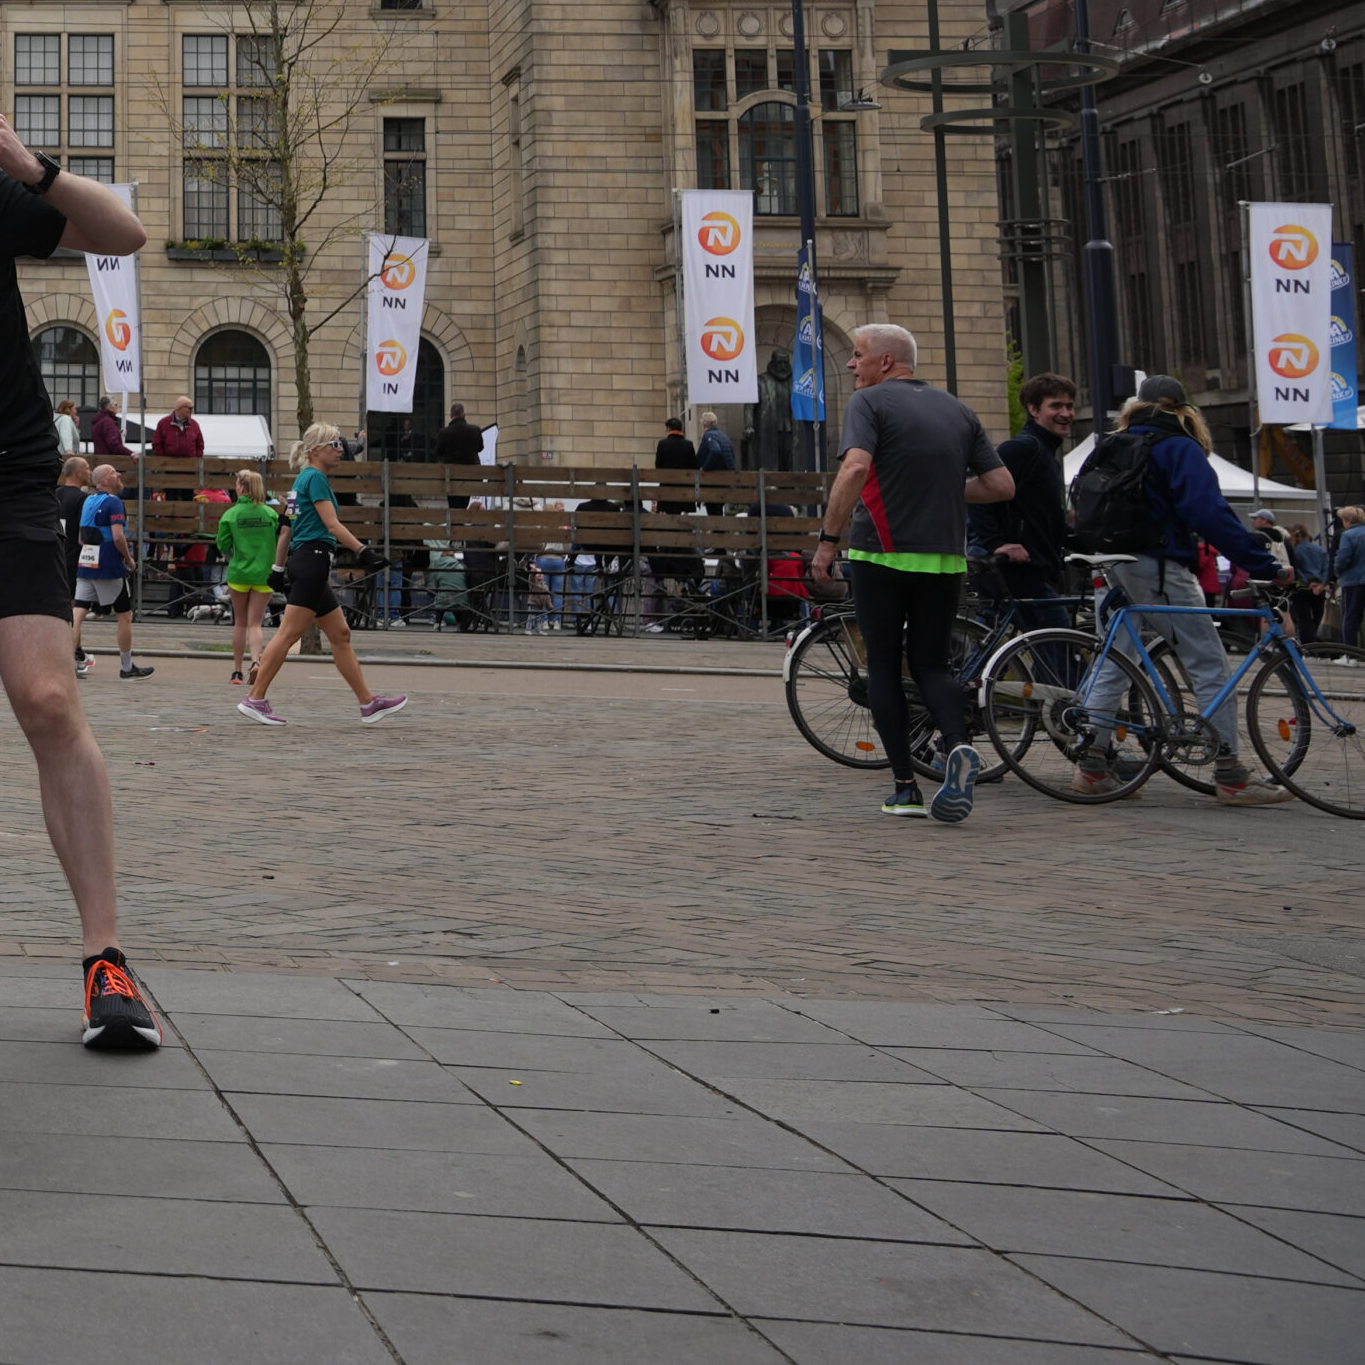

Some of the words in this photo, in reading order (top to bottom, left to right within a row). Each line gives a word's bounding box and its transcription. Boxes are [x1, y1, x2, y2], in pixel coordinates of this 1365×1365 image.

[705, 264, 736, 278] NN
[1276, 279, 1310, 294] NN
[382, 296, 406, 309] NN
[708, 369, 739, 383] NN
[1275, 387, 1310, 402] NN
